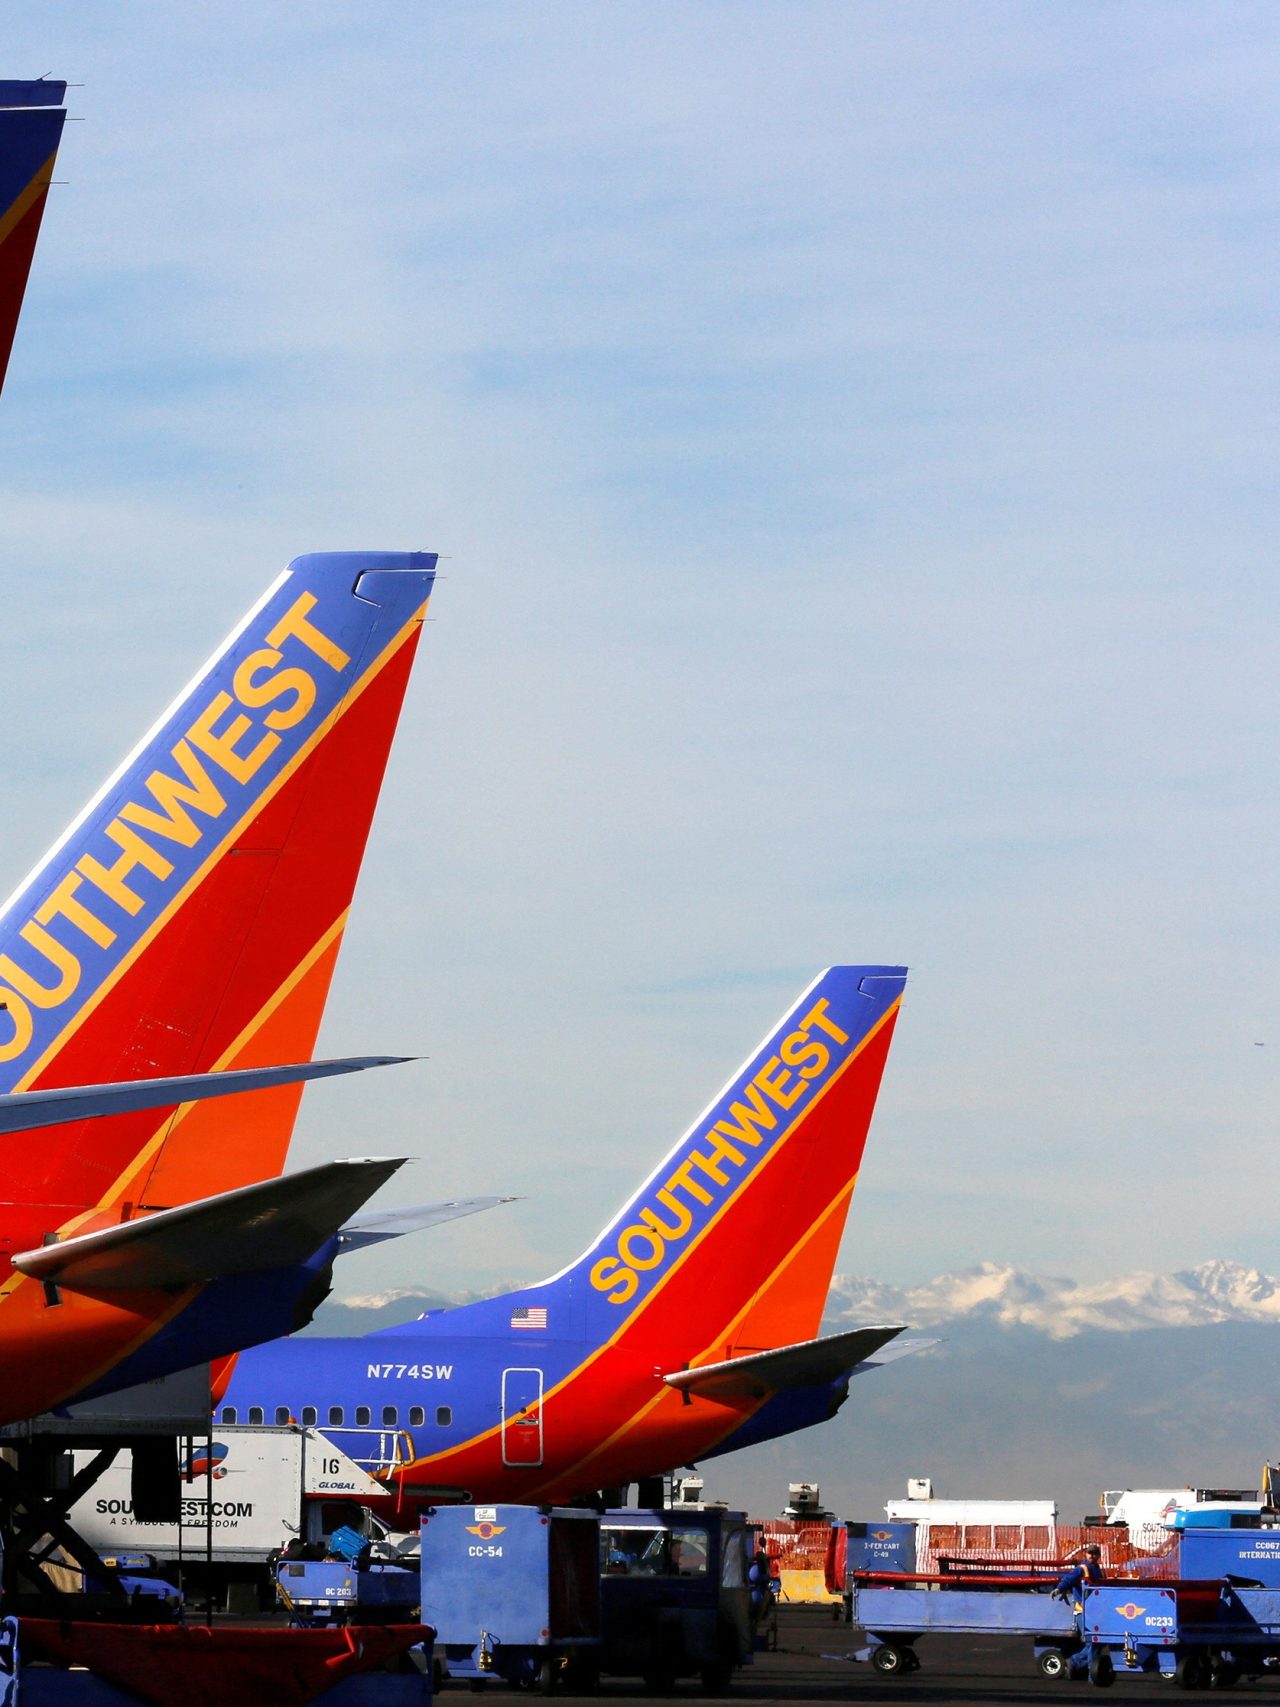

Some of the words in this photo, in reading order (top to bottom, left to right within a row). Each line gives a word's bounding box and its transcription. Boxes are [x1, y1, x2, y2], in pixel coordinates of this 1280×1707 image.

[589, 997, 850, 1305] SOUTHWEST
[367, 1364, 453, 1380] N774SW
[322, 1458, 340, 1475] 16
[318, 1481, 356, 1490] GLOBAL
[468, 1546, 503, 1557] CC-54
